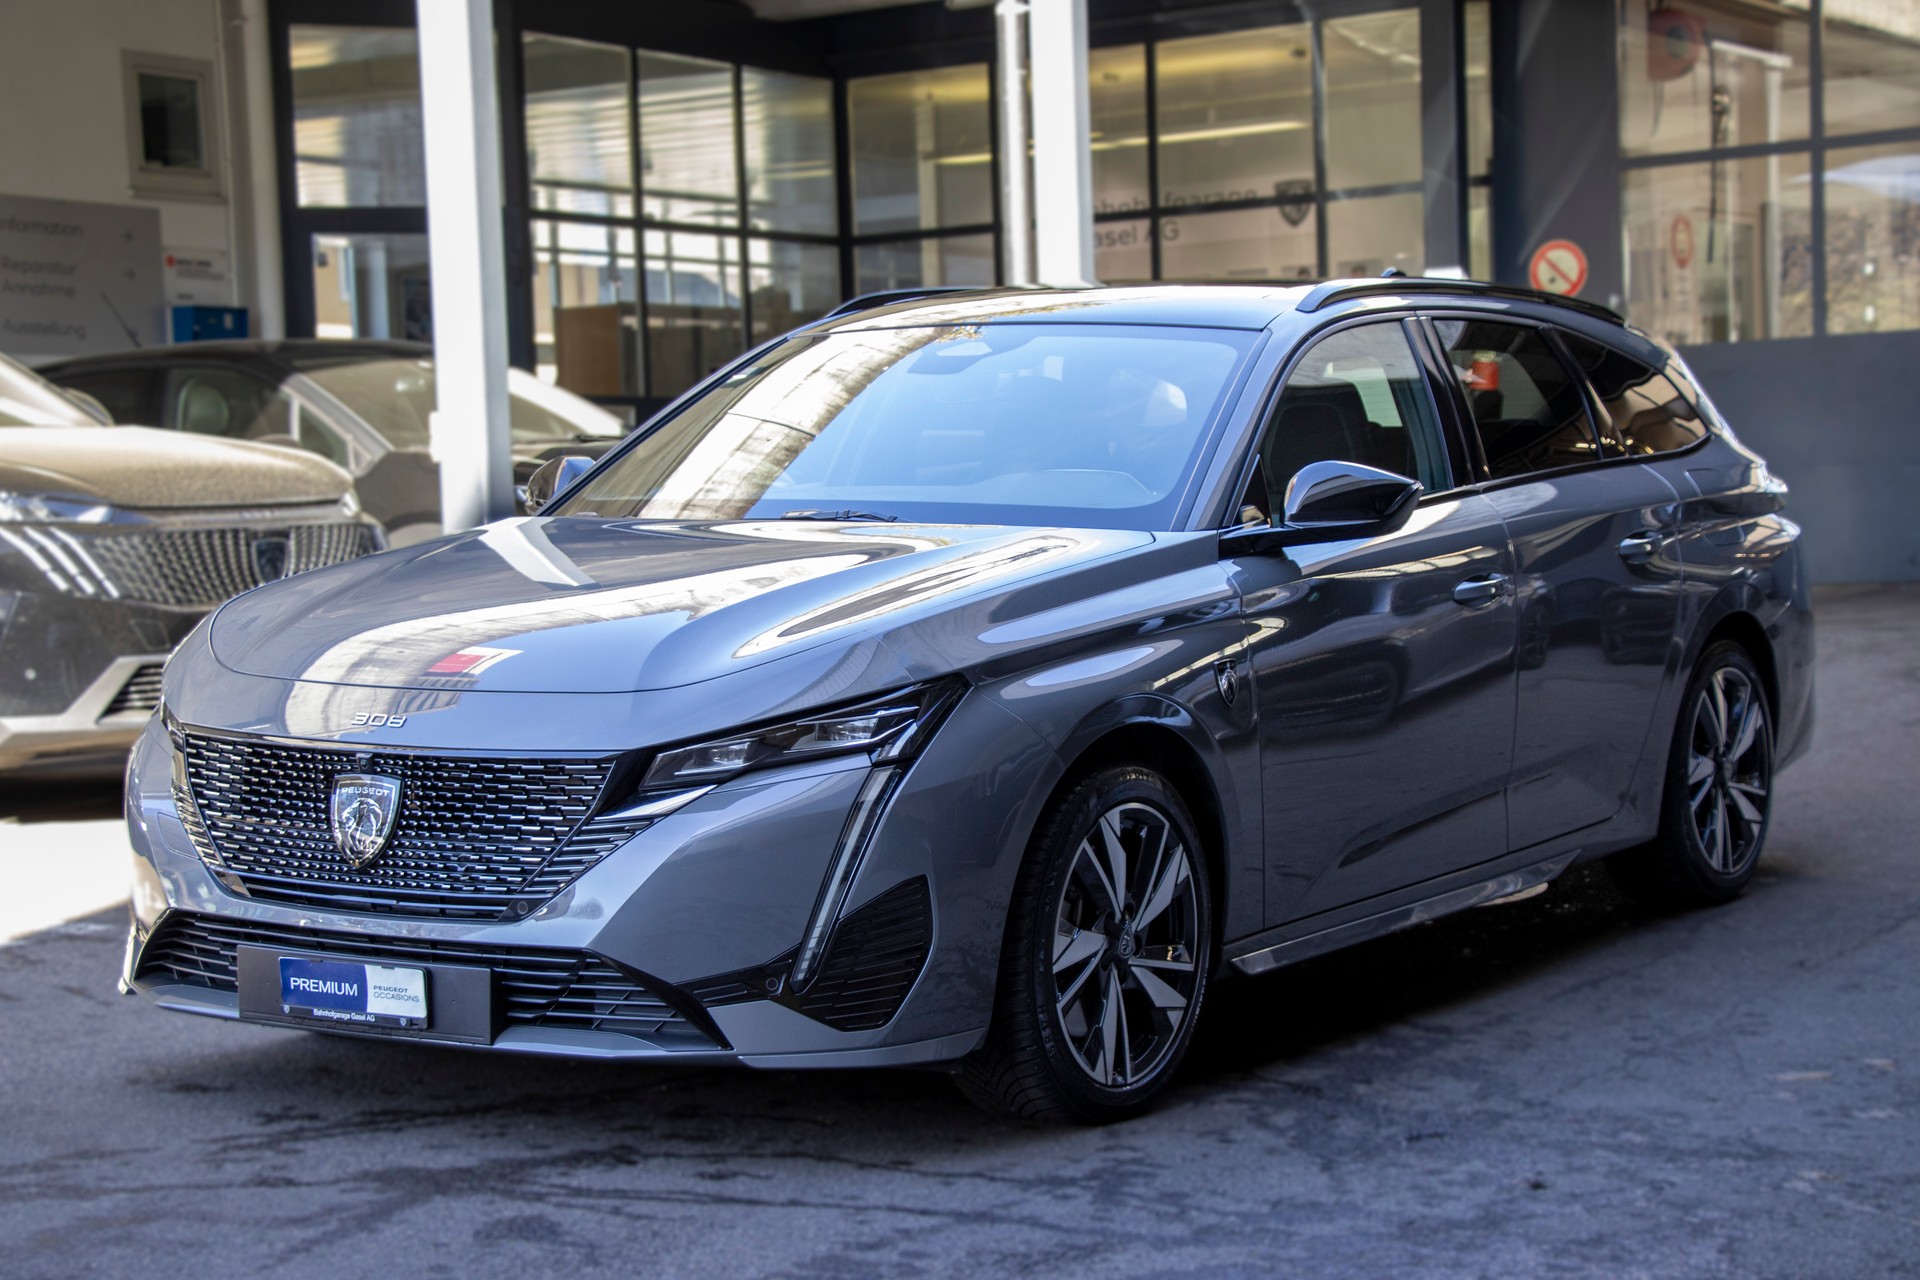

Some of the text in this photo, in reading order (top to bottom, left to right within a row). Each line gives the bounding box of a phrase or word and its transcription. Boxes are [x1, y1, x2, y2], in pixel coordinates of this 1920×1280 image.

[351, 711, 407, 728] 308
[341, 786, 390, 797] PEUGEOT
[290, 977, 358, 996] PREMIUM
[373, 984, 408, 993] PEUGEOT
[373, 991, 419, 1002] OCCASIONS
[366, 1014, 375, 1022] AG
